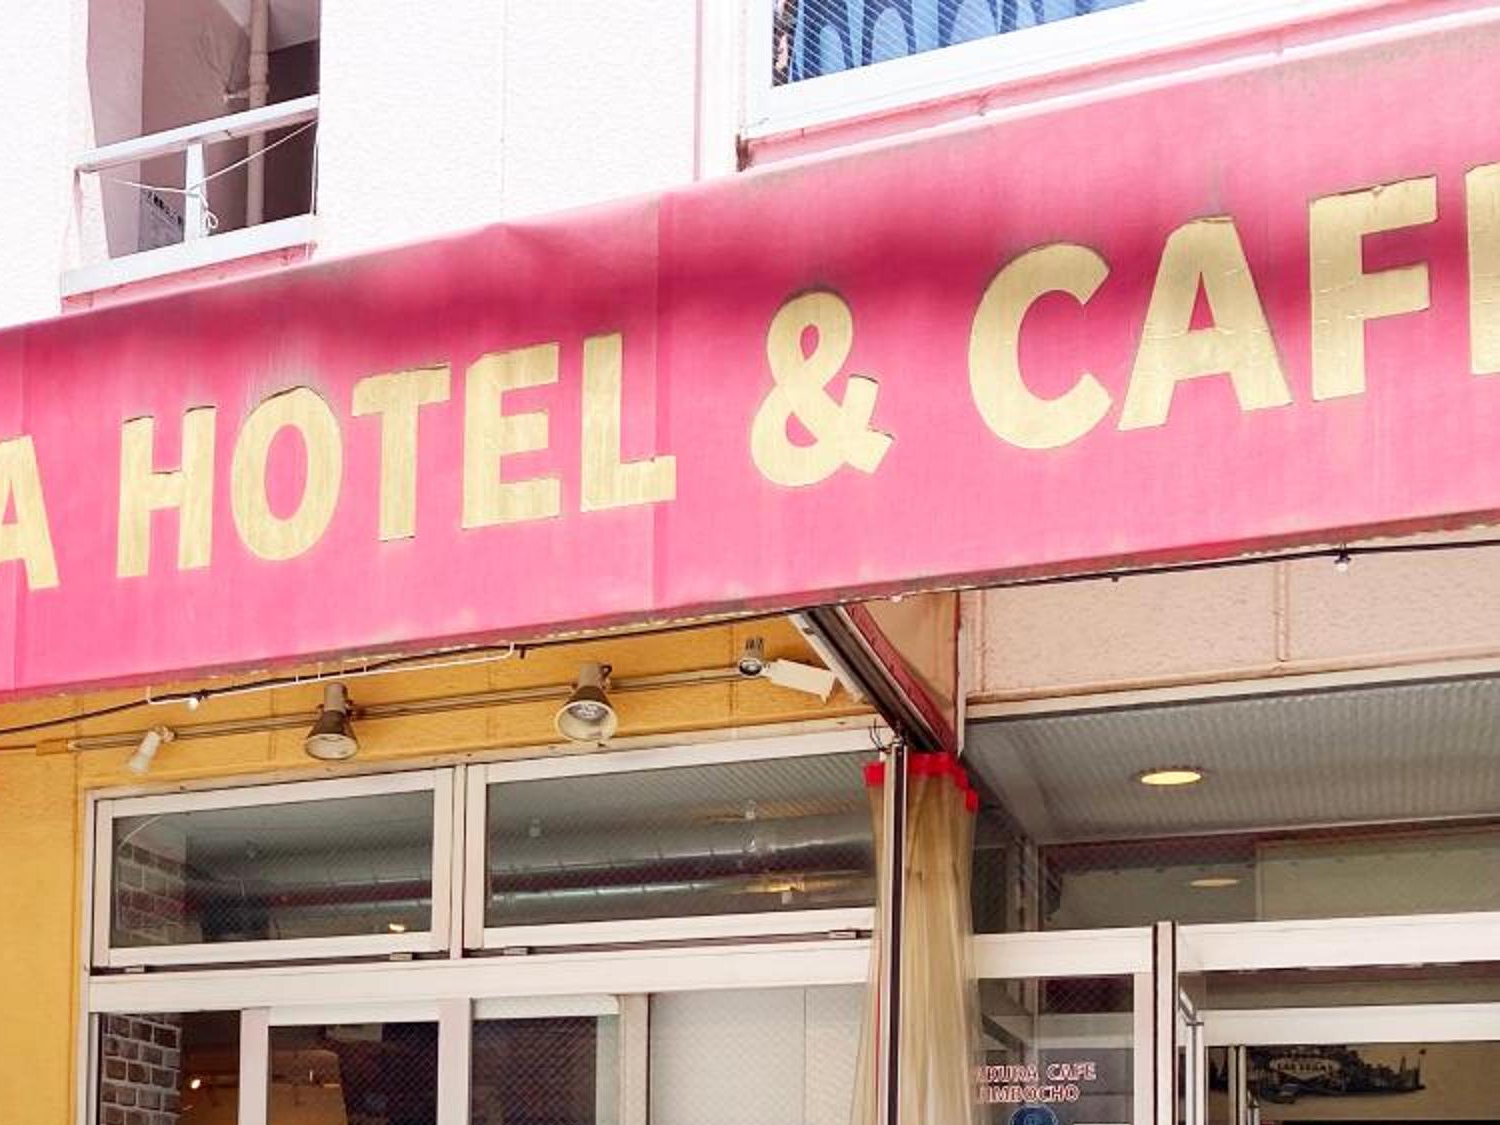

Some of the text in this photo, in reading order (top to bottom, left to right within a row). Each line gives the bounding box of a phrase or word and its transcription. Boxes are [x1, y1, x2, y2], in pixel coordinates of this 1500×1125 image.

[116, 332, 678, 579] HOTEL
[750, 289, 894, 487] &
[967, 162, 1500, 450] CAF
[1047, 1061, 1097, 1080] CAFE
